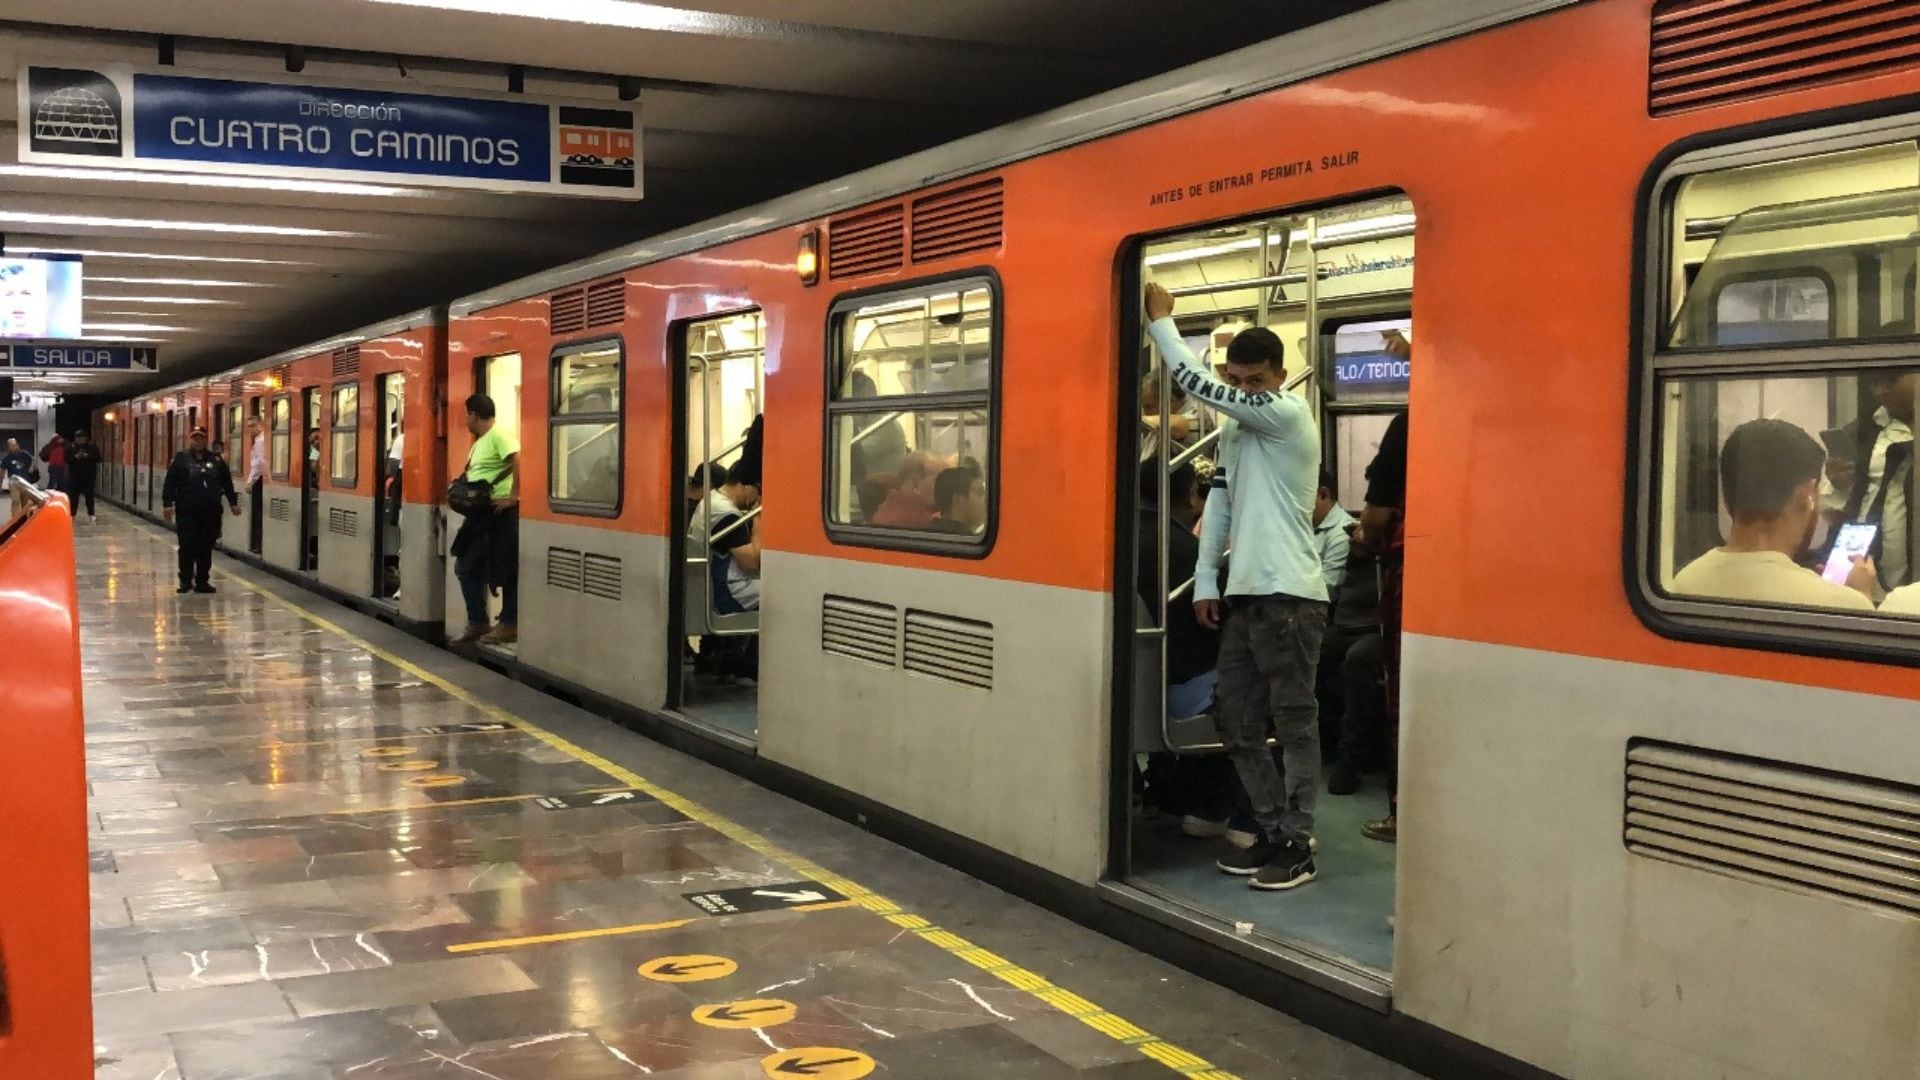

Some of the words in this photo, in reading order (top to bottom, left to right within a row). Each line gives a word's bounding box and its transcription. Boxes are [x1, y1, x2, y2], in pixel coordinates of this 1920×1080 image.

[299, 100, 401, 122] DIRECCIÓN
[170, 116, 331, 154] CUATRO
[350, 128, 520, 166] CAMINOS
[1150, 187, 1183, 206] ANTES
[1189, 184, 1203, 198] DE
[1209, 173, 1254, 193] ENTRAR
[1261, 160, 1313, 183] PERMITA
[1320, 150, 1359, 170] SALIR
[33, 349, 112, 366] SALIDA
